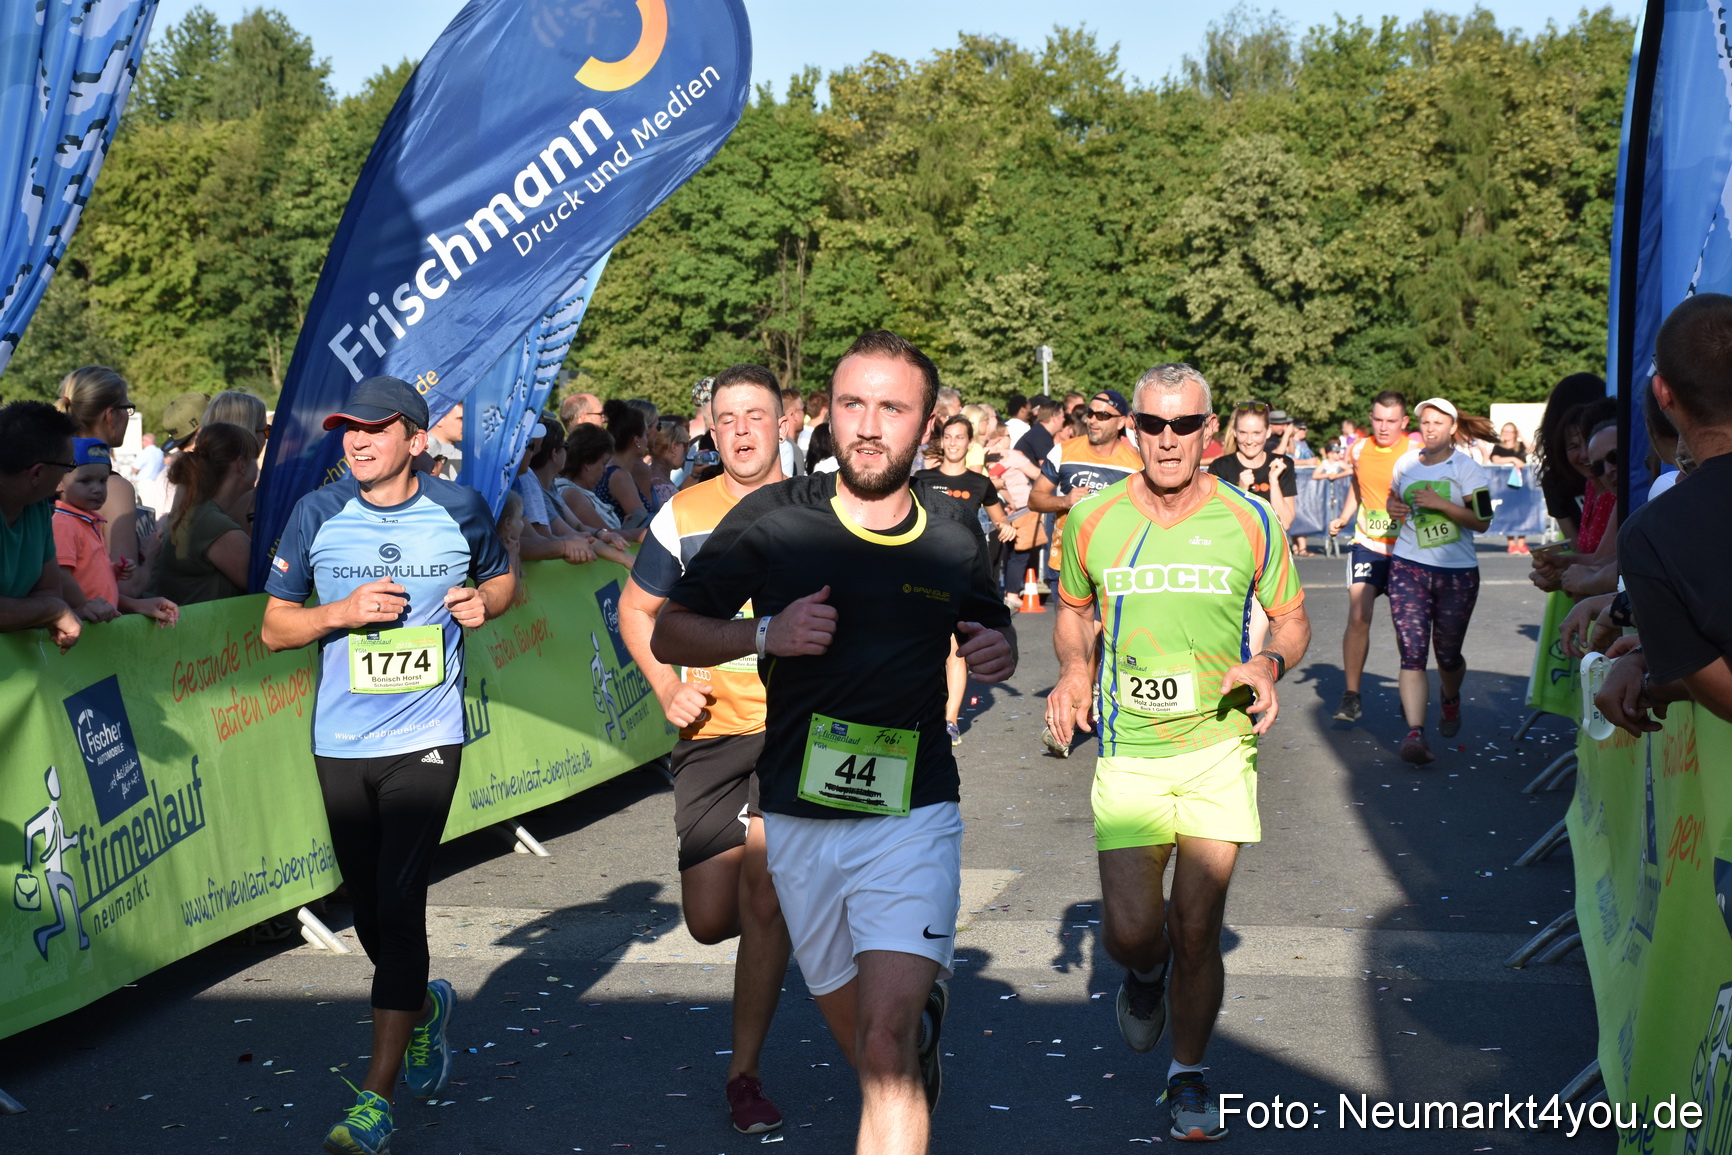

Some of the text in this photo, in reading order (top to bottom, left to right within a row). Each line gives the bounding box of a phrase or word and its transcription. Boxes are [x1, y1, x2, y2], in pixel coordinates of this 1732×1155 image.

[512, 66, 720, 256] Druck und Medien
[328, 107, 614, 382] Frischmann
[1369, 519, 1397, 531] 2085
[1424, 523, 1449, 538] 116
[332, 564, 448, 579] SCHABMÜLLER
[1103, 563, 1232, 597] BOCK
[1354, 562, 1373, 578] 22
[172, 632, 241, 703] Gesunde
[361, 649, 431, 675] 1774
[1130, 677, 1178, 701] 230
[211, 686, 264, 743] laufen
[1133, 698, 1178, 708] Holz Joachim
[86, 722, 122, 755] Fischer
[822, 730, 862, 745] firmenlauf
[874, 728, 903, 745] Fabi
[97, 743, 124, 766] AUTOMOBILE
[835, 754, 877, 787] 44
[79, 755, 205, 905] firmenlauf
[94, 873, 150, 935] neumarkt
